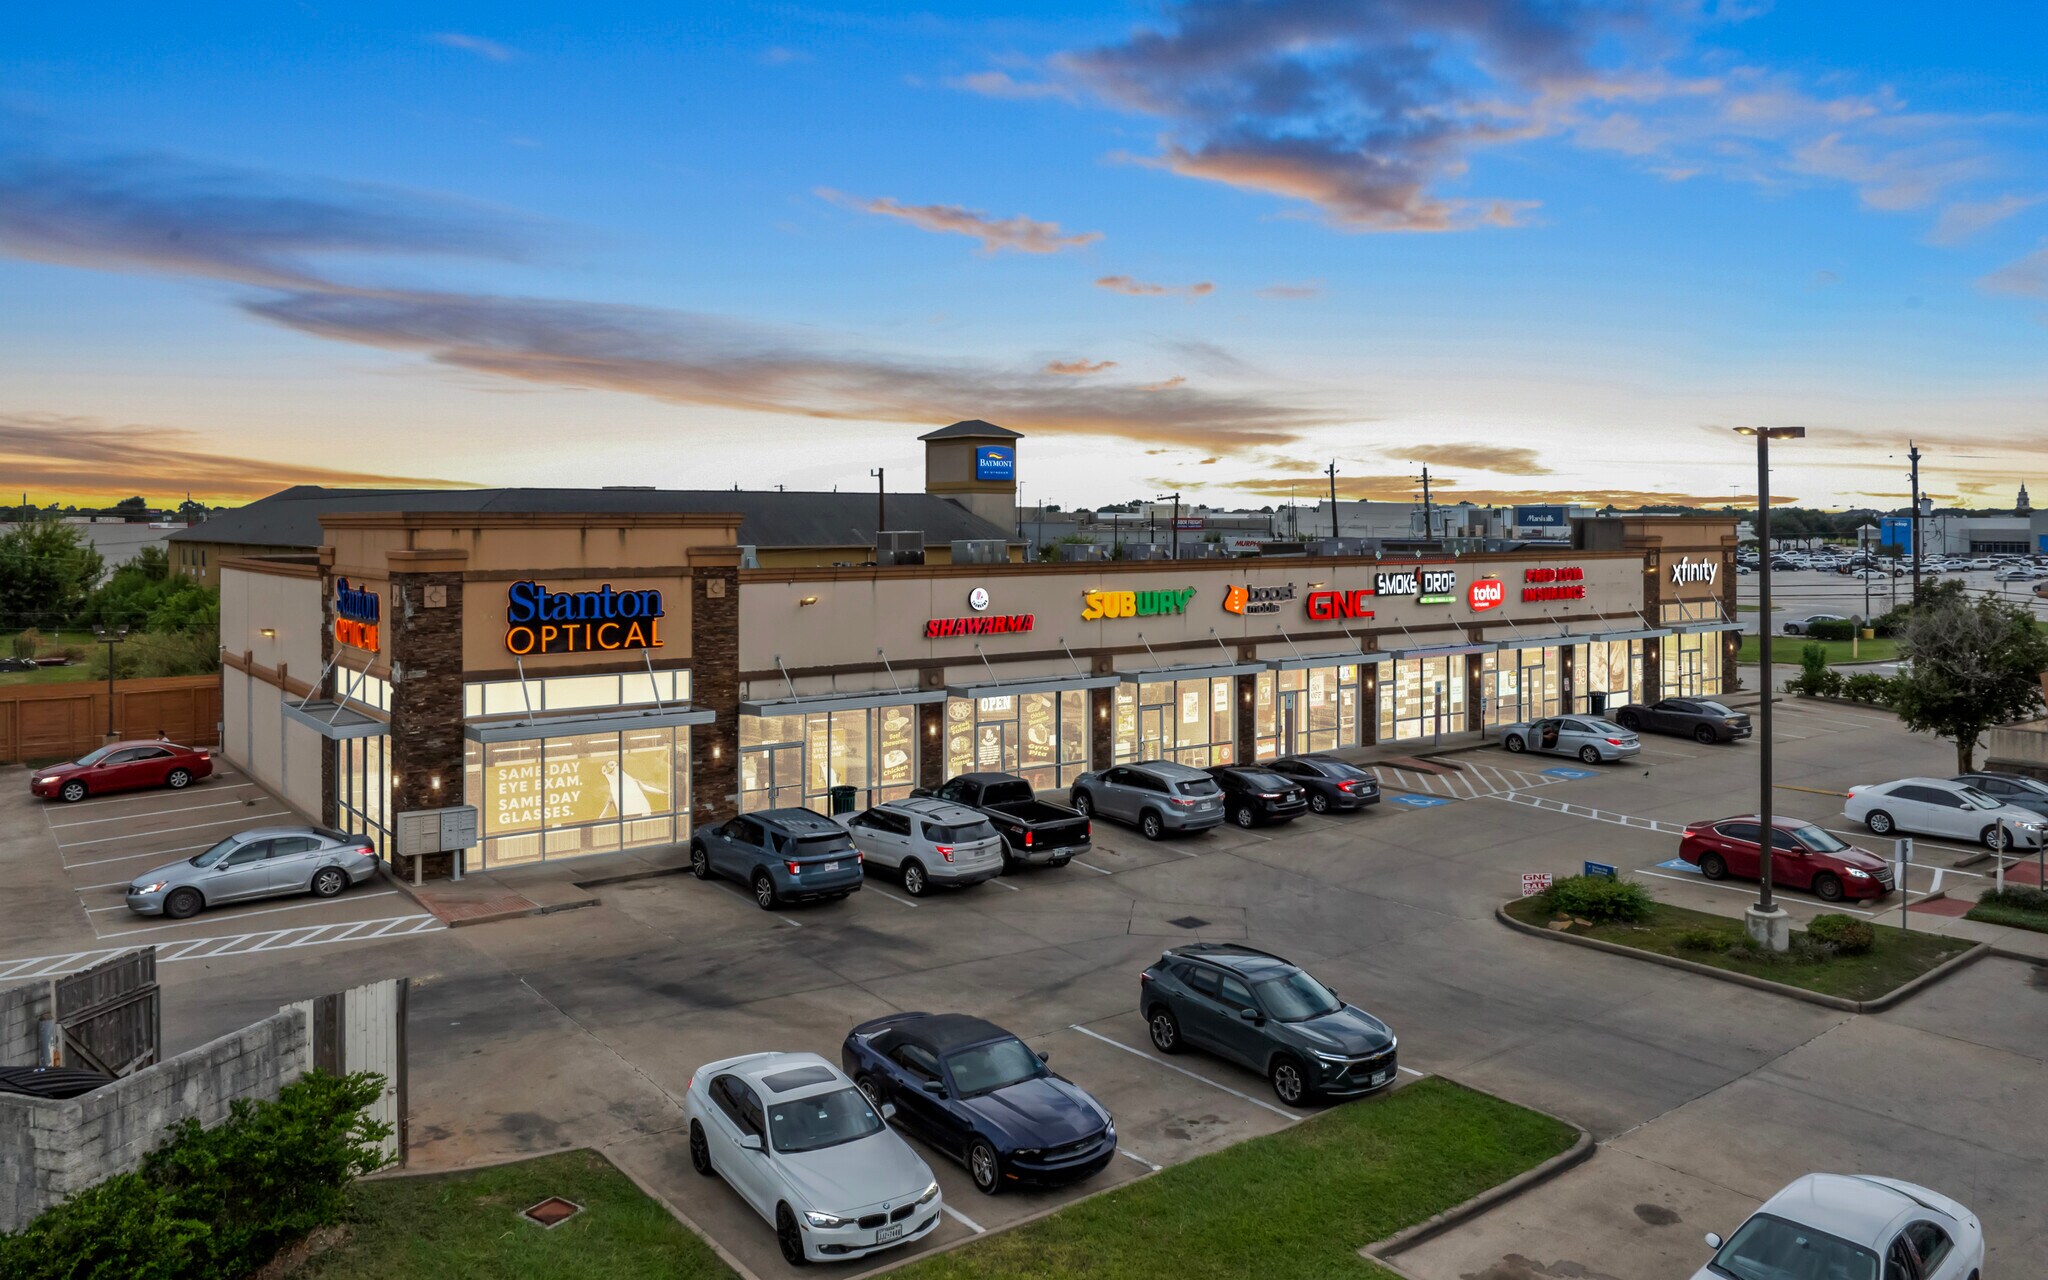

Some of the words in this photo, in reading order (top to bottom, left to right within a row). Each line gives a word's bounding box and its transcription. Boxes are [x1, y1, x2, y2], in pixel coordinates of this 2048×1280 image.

[980, 459, 1013, 468] BAYMONT
[1672, 556, 1718, 586] xfinity
[1246, 582, 1298, 602] boost
[1376, 573, 1418, 596] SMOKE
[1422, 571, 1456, 594] DROP
[1473, 582, 1501, 600] total
[508, 581, 664, 622] Stanton
[1081, 586, 1197, 621] SUBWAY
[1522, 585, 1586, 602] INSURANCE
[1246, 603, 1280, 614] mobile
[1307, 589, 1375, 620] GNC
[926, 613, 1035, 637] SHAWARMA
[506, 619, 665, 655] OPTICAL
[981, 695, 1011, 712] OPEN
[1028, 743, 1050, 751] Gyro
[1028, 749, 1048, 757] Pita
[498, 761, 580, 781] SAME-DAY
[883, 765, 909, 776] Chicken
[891, 771, 906, 780] Pita
[499, 780, 527, 795] EYE
[534, 775, 583, 789] EXAM.
[498, 790, 581, 811] SAME-DAY
[499, 805, 574, 825] GLASSES.
